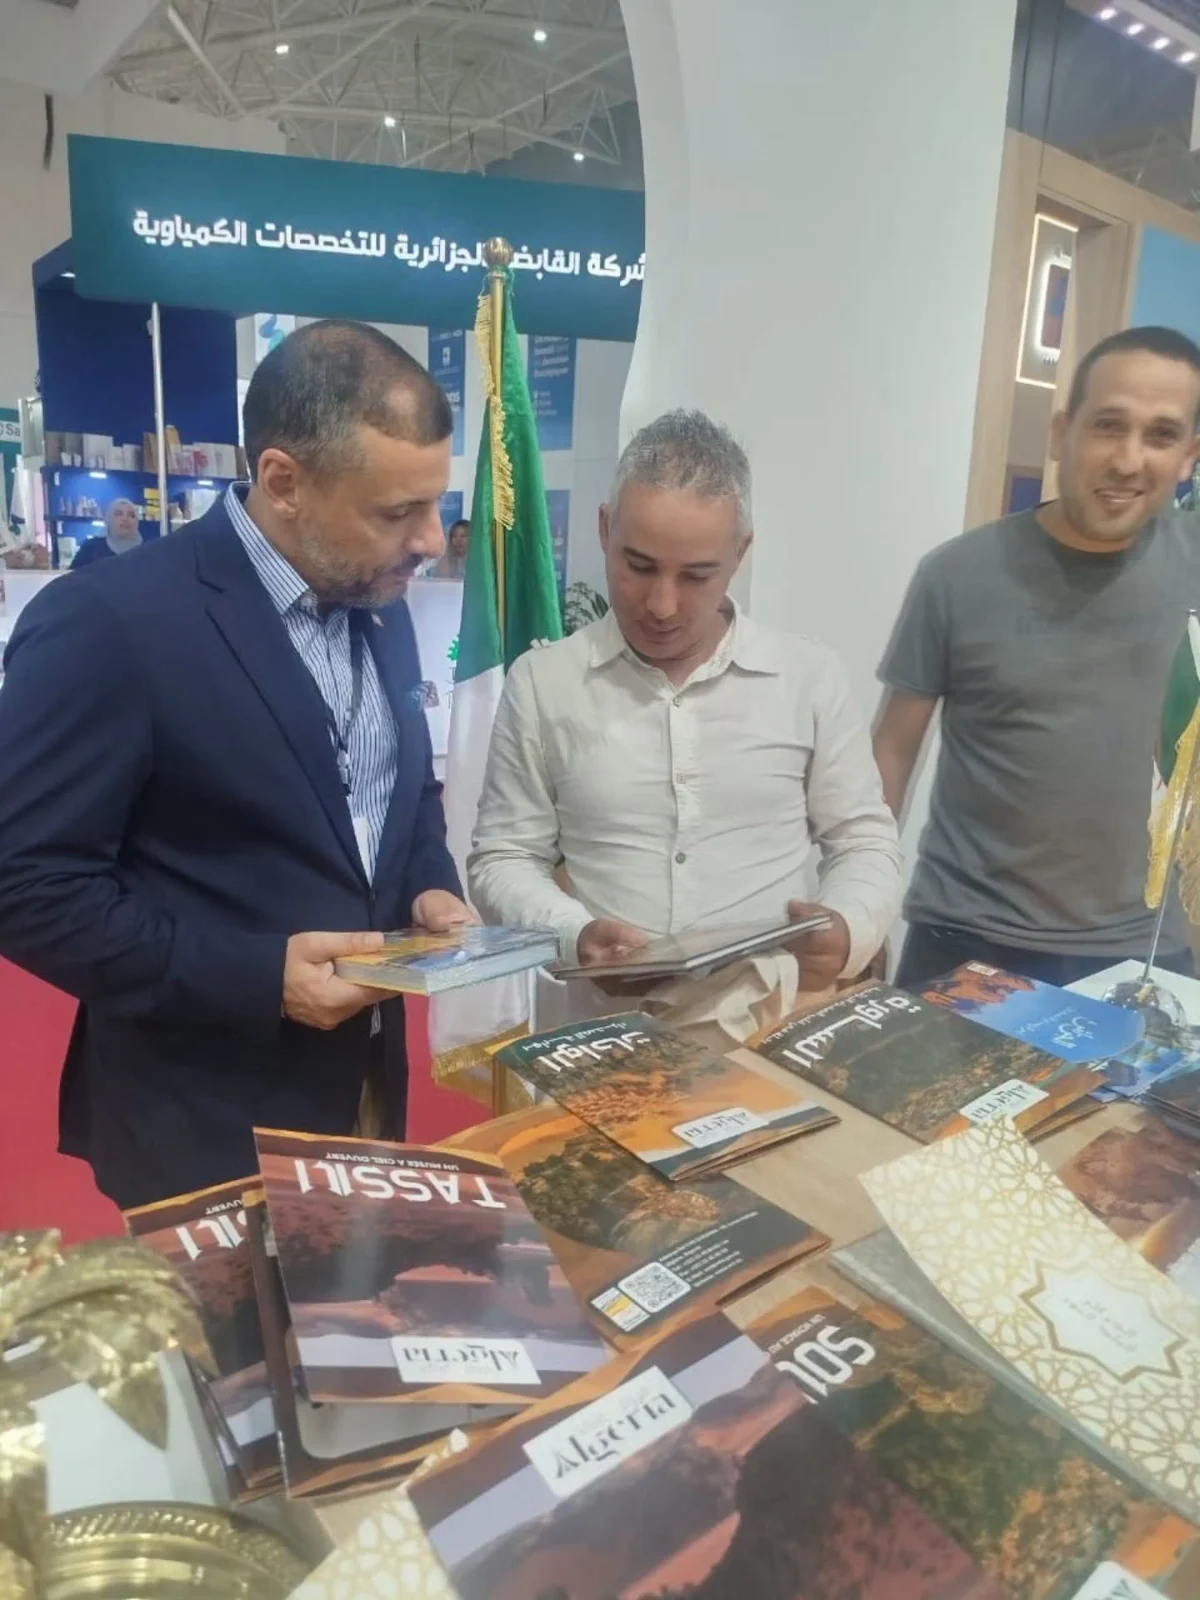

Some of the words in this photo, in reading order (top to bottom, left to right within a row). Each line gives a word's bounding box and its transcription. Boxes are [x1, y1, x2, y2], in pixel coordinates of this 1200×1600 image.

[133, 209, 247, 248] الكمياوية
[255, 222, 386, 257] للتخصصات
[508, 244, 580, 280] القابض
[587, 251, 646, 287] شركة
[537, 1031, 651, 1072] الواحات
[294, 1159, 507, 1209] TASSILI
[205, 1199, 242, 1216] UVERT
[403, 1343, 520, 1372] Algeria
[554, 1392, 676, 1479] Algeria
